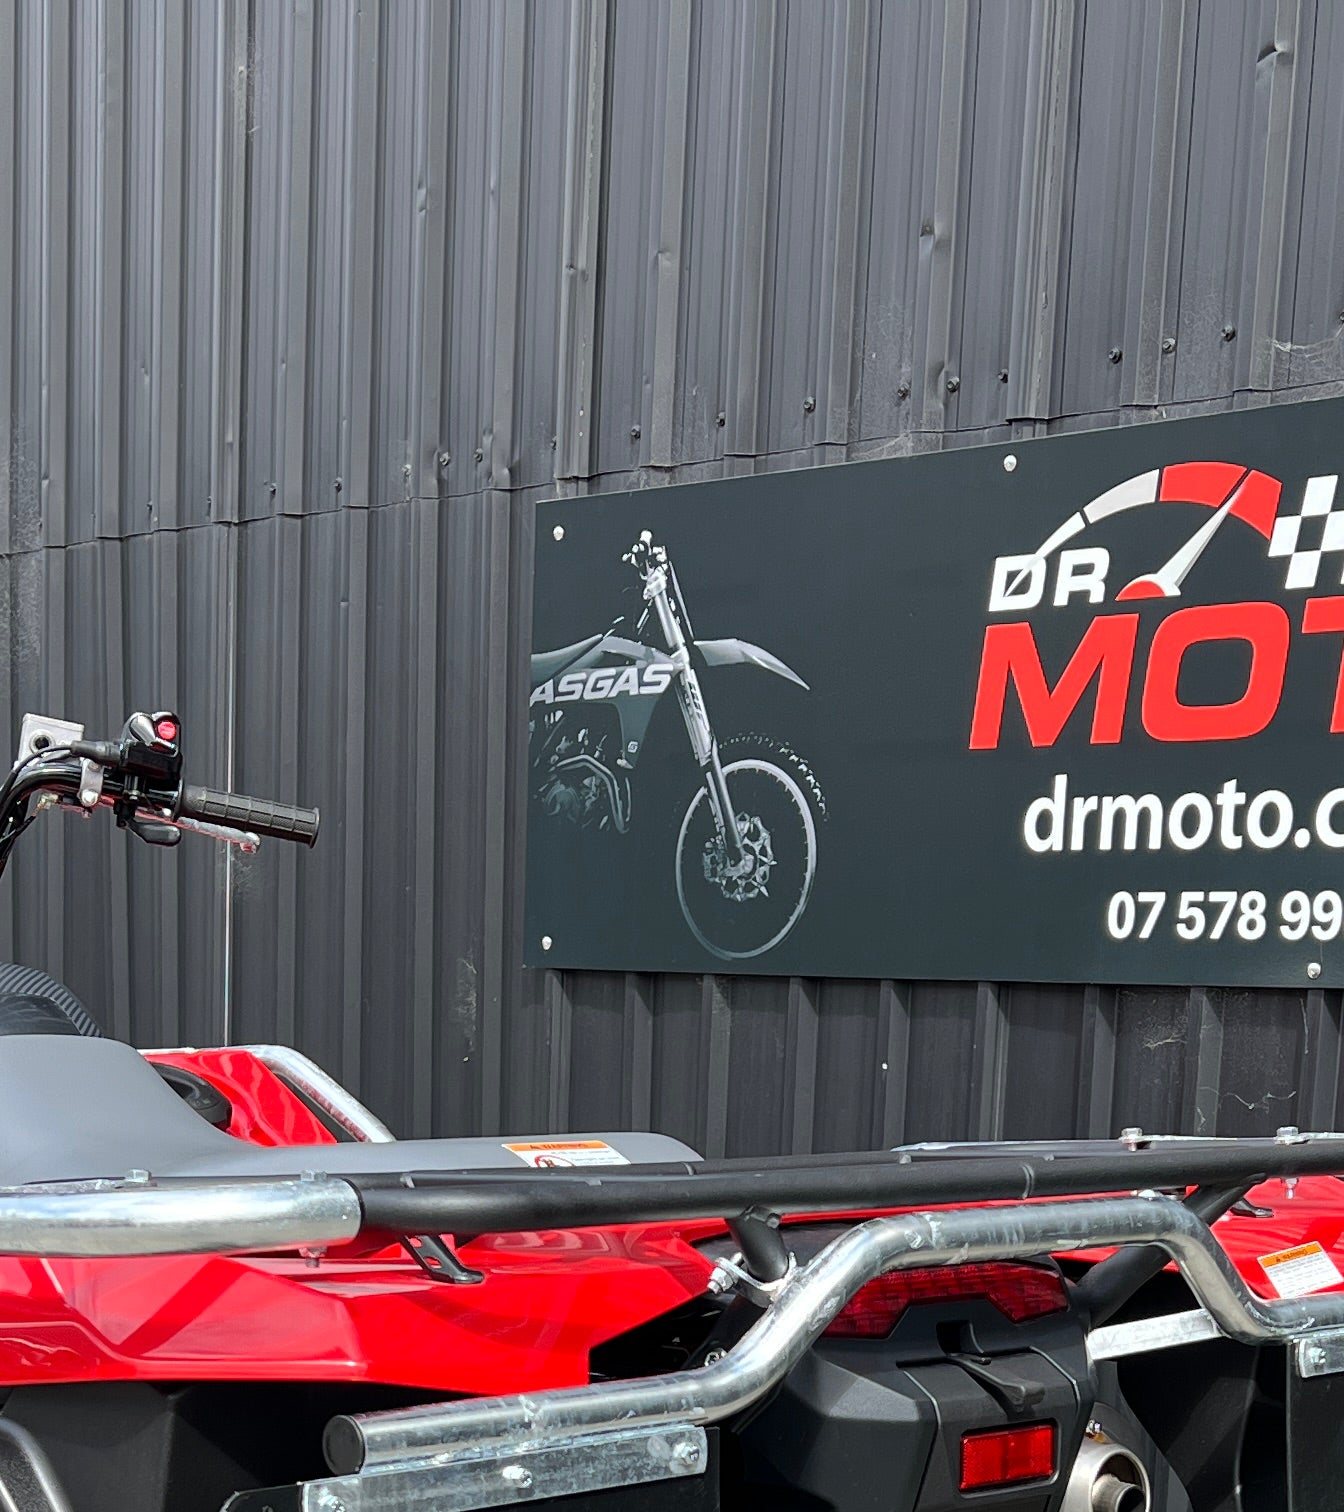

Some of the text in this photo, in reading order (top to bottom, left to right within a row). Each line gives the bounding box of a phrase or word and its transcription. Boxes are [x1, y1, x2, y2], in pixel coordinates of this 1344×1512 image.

[988, 546, 1111, 612] DR
[1107, 891, 1165, 940] 07
[1177, 891, 1267, 940] 578
